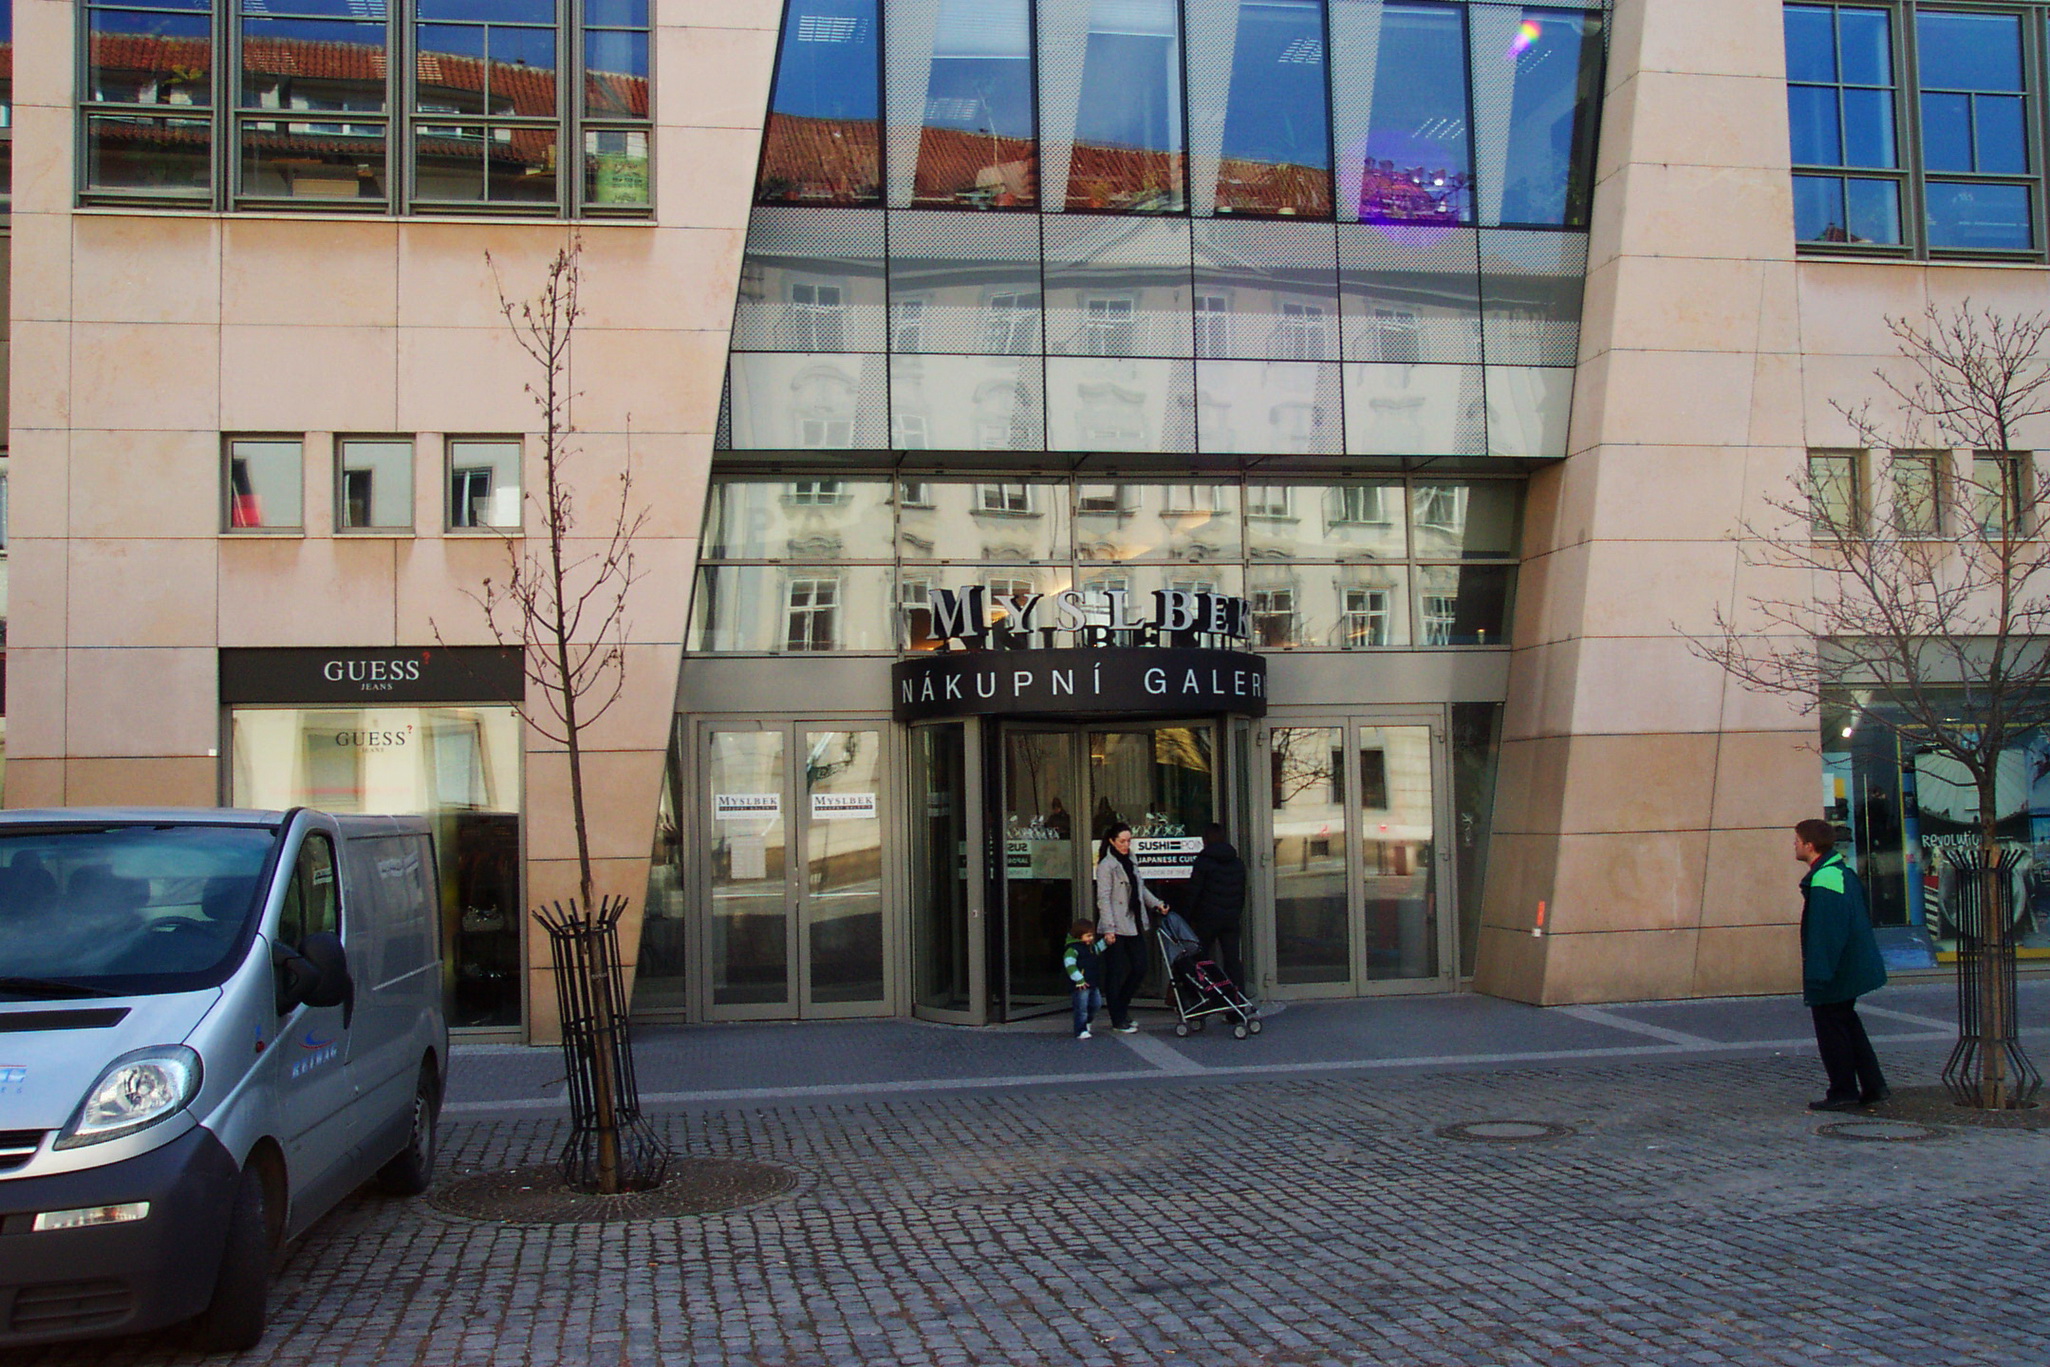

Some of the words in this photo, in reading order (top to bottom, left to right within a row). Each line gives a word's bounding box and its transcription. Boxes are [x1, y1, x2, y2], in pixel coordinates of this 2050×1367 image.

[927, 585, 1251, 640] MYSLBEK
[361, 683, 393, 691] JEANS
[902, 662, 1101, 703] NÁKUPNÍ
[719, 796, 777, 805] MYSLBEK
[815, 796, 872, 805] MYSLBEK
[1138, 841, 1170, 851] SUSHI
[1138, 856, 1178, 864] JAPANESE
